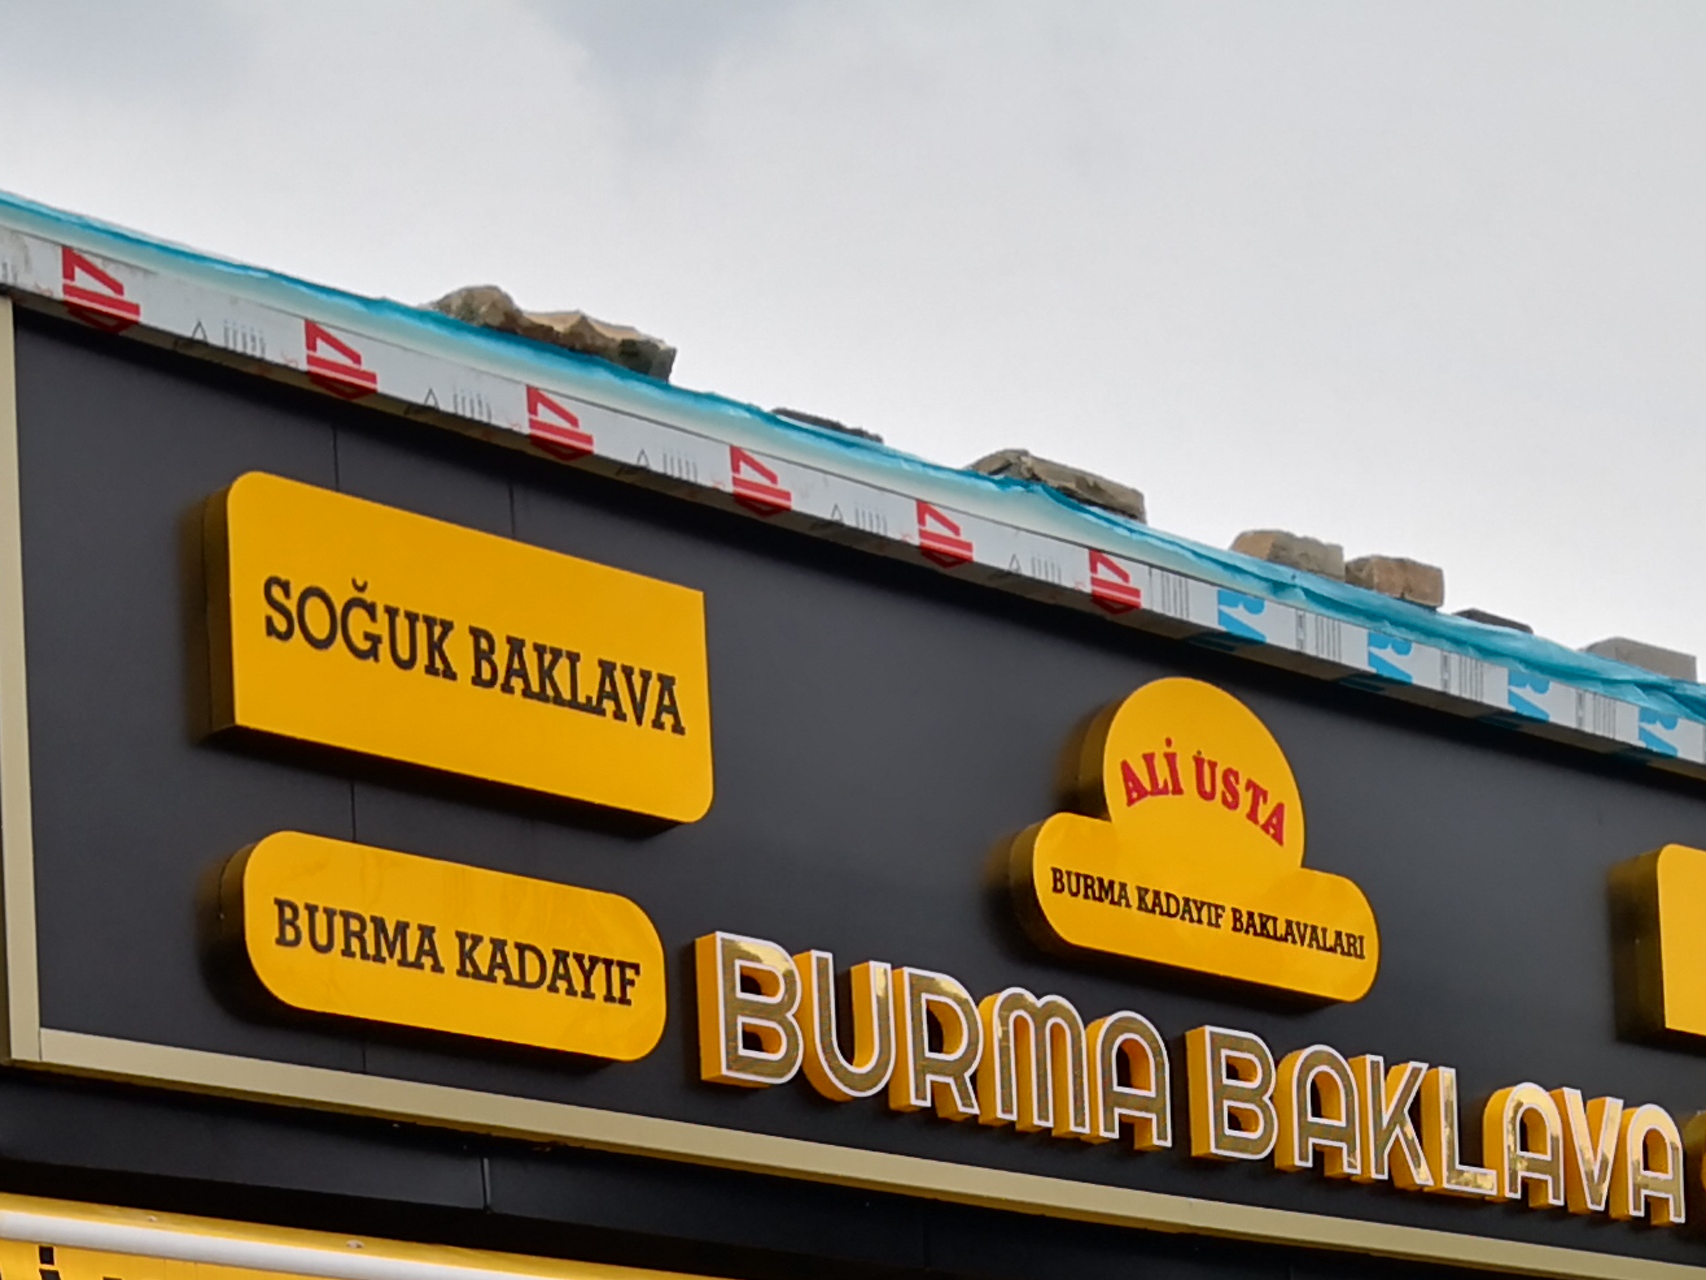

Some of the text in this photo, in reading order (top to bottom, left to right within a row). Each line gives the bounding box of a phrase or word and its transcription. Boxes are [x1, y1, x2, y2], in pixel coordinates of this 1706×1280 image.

[262, 577, 686, 736] SOĞUK BAKLAVA
[1119, 736, 1286, 847] ALİ USTA
[272, 897, 642, 1007] BURMA KADAYIF
[1050, 867, 1366, 960] BURMA KADAYIF BAKLAVALARI
[703, 930, 1686, 1224] BURMA BAKLAVA
